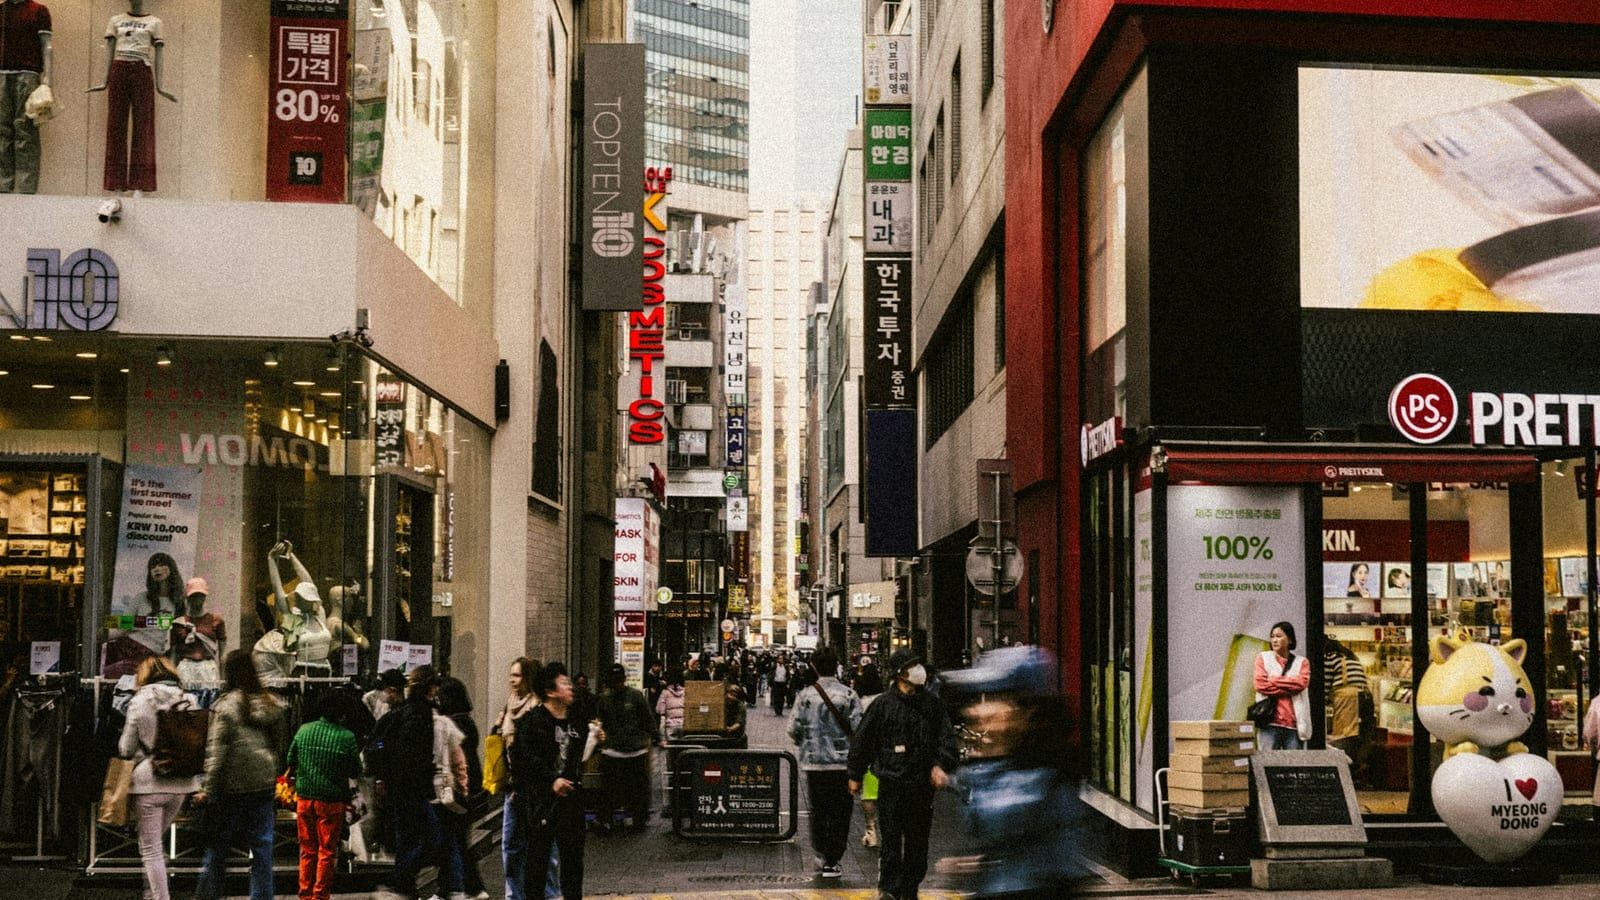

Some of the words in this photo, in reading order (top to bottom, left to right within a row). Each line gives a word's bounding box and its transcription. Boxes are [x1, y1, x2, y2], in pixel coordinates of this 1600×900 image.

[287, 32, 331, 54] 특별
[286, 58, 330, 81] 가격
[899, 71, 909, 95] 의원
[276, 89, 339, 123] 80%
[871, 125, 910, 139] 아이닥
[872, 146, 909, 165] 안경
[295, 157, 316, 175] 10
[872, 199, 895, 246] 내과
[629, 237, 665, 444] COSMETICS
[877, 263, 902, 366] 한국투자
[891, 370, 905, 400] 증권
[728, 310, 745, 388] 유천냉면
[728, 418, 744, 463] 고시텔
[148, 479, 165, 488] the
[130, 488, 149, 497] first
[150, 490, 192, 500] summer
[126, 531, 173, 543] discount
[127, 522, 152, 533] KRW
[615, 553, 637, 562] FOR
[1203, 535, 1274, 560] 100%
[613, 577, 639, 586] SKIN
[1503, 778, 1513, 802] I
[1491, 803, 1547, 817] MYEONG
[1500, 816, 1539, 830] DONG
